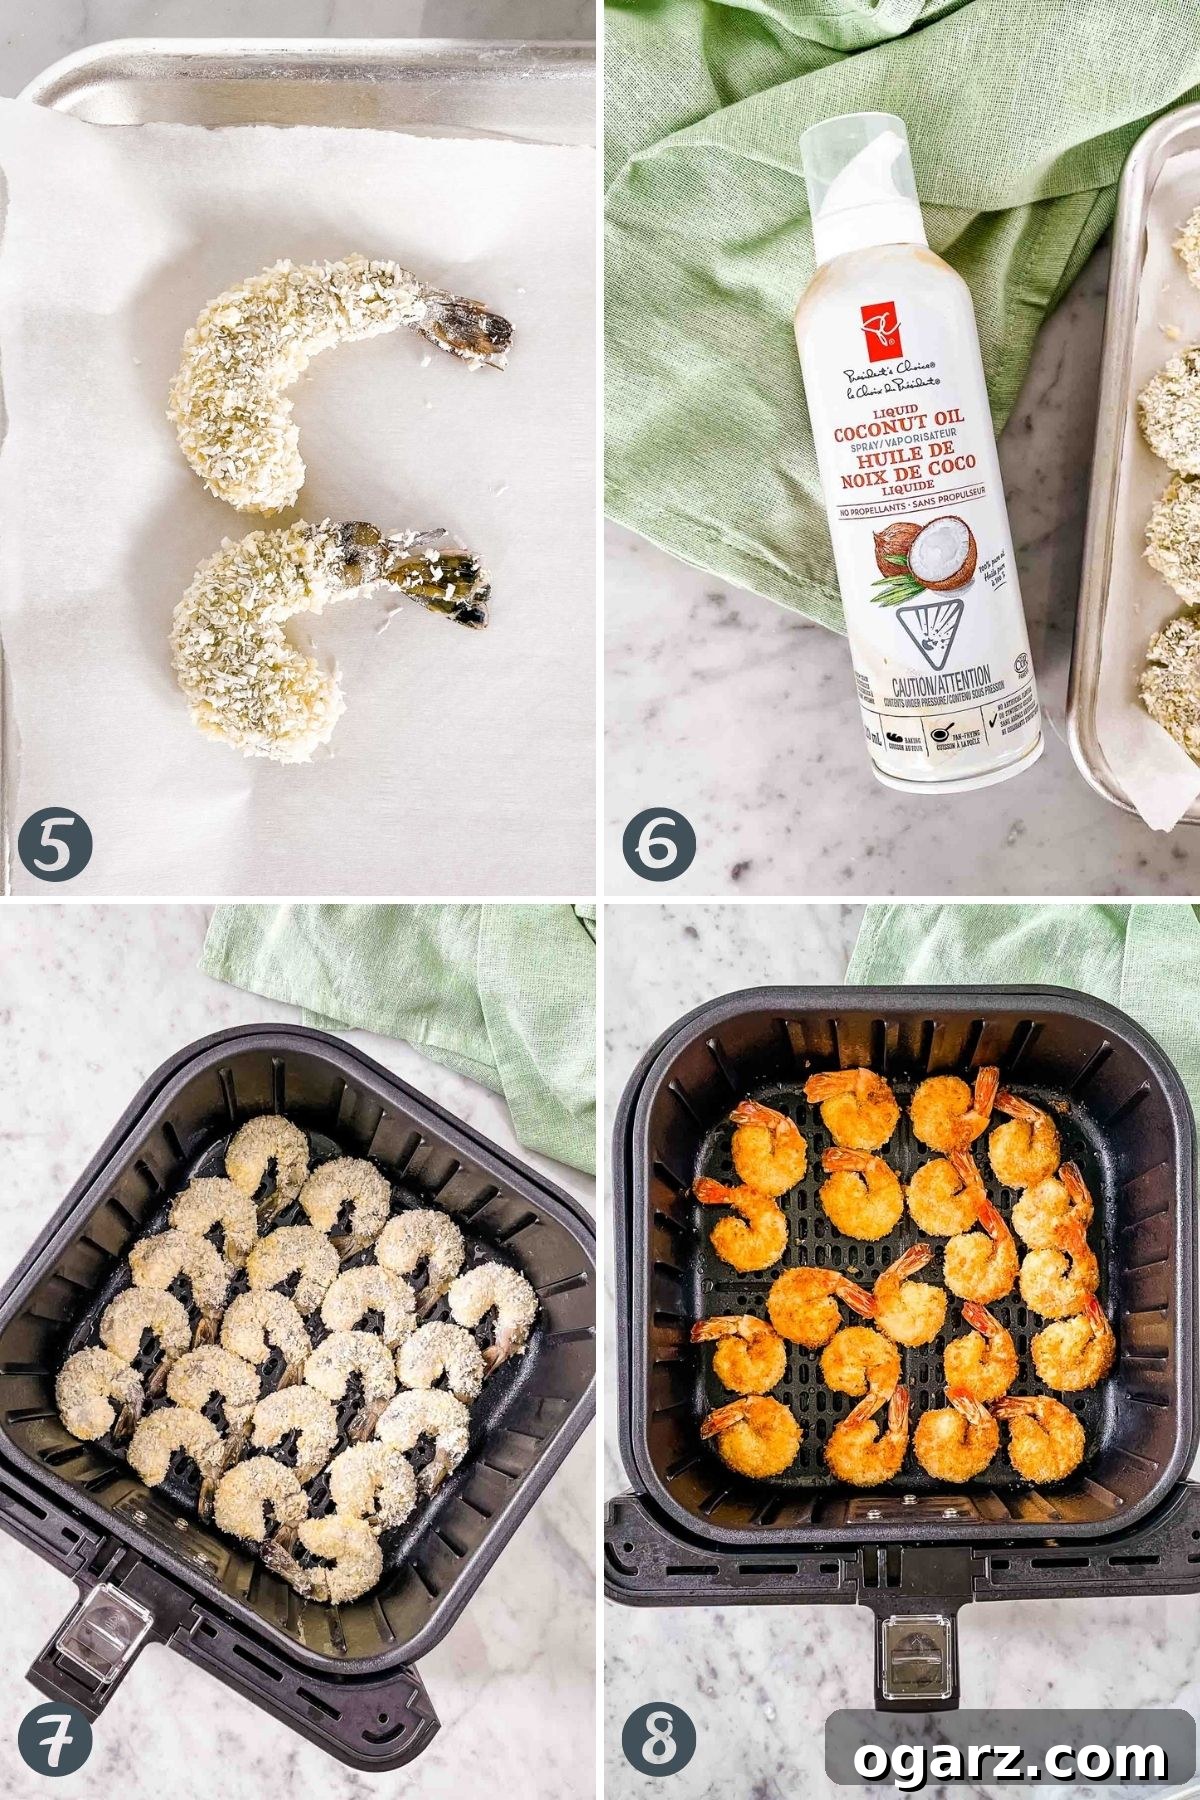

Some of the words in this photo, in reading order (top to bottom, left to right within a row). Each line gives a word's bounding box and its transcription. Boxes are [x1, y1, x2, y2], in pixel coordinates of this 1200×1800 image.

[856, 384, 882, 398] Choix
[834, 413, 928, 443] COCONUT
[934, 408, 965, 426] OIL
[873, 403, 918, 420] LIQUID
[856, 446, 923, 469] HUILE
[928, 440, 955, 458] DE
[841, 469, 888, 489] NOIX
[893, 464, 922, 482] DE
[928, 454, 977, 477] COCO
[840, 509, 850, 517] NO
[850, 500, 906, 517] PROPELLANTS
[913, 497, 936, 509] SANS
[938, 486, 986, 504] PROPULSEUR
[882, 479, 935, 496] LIQUIDE
[892, 664, 992, 698] CAUTION/ATTENTION
